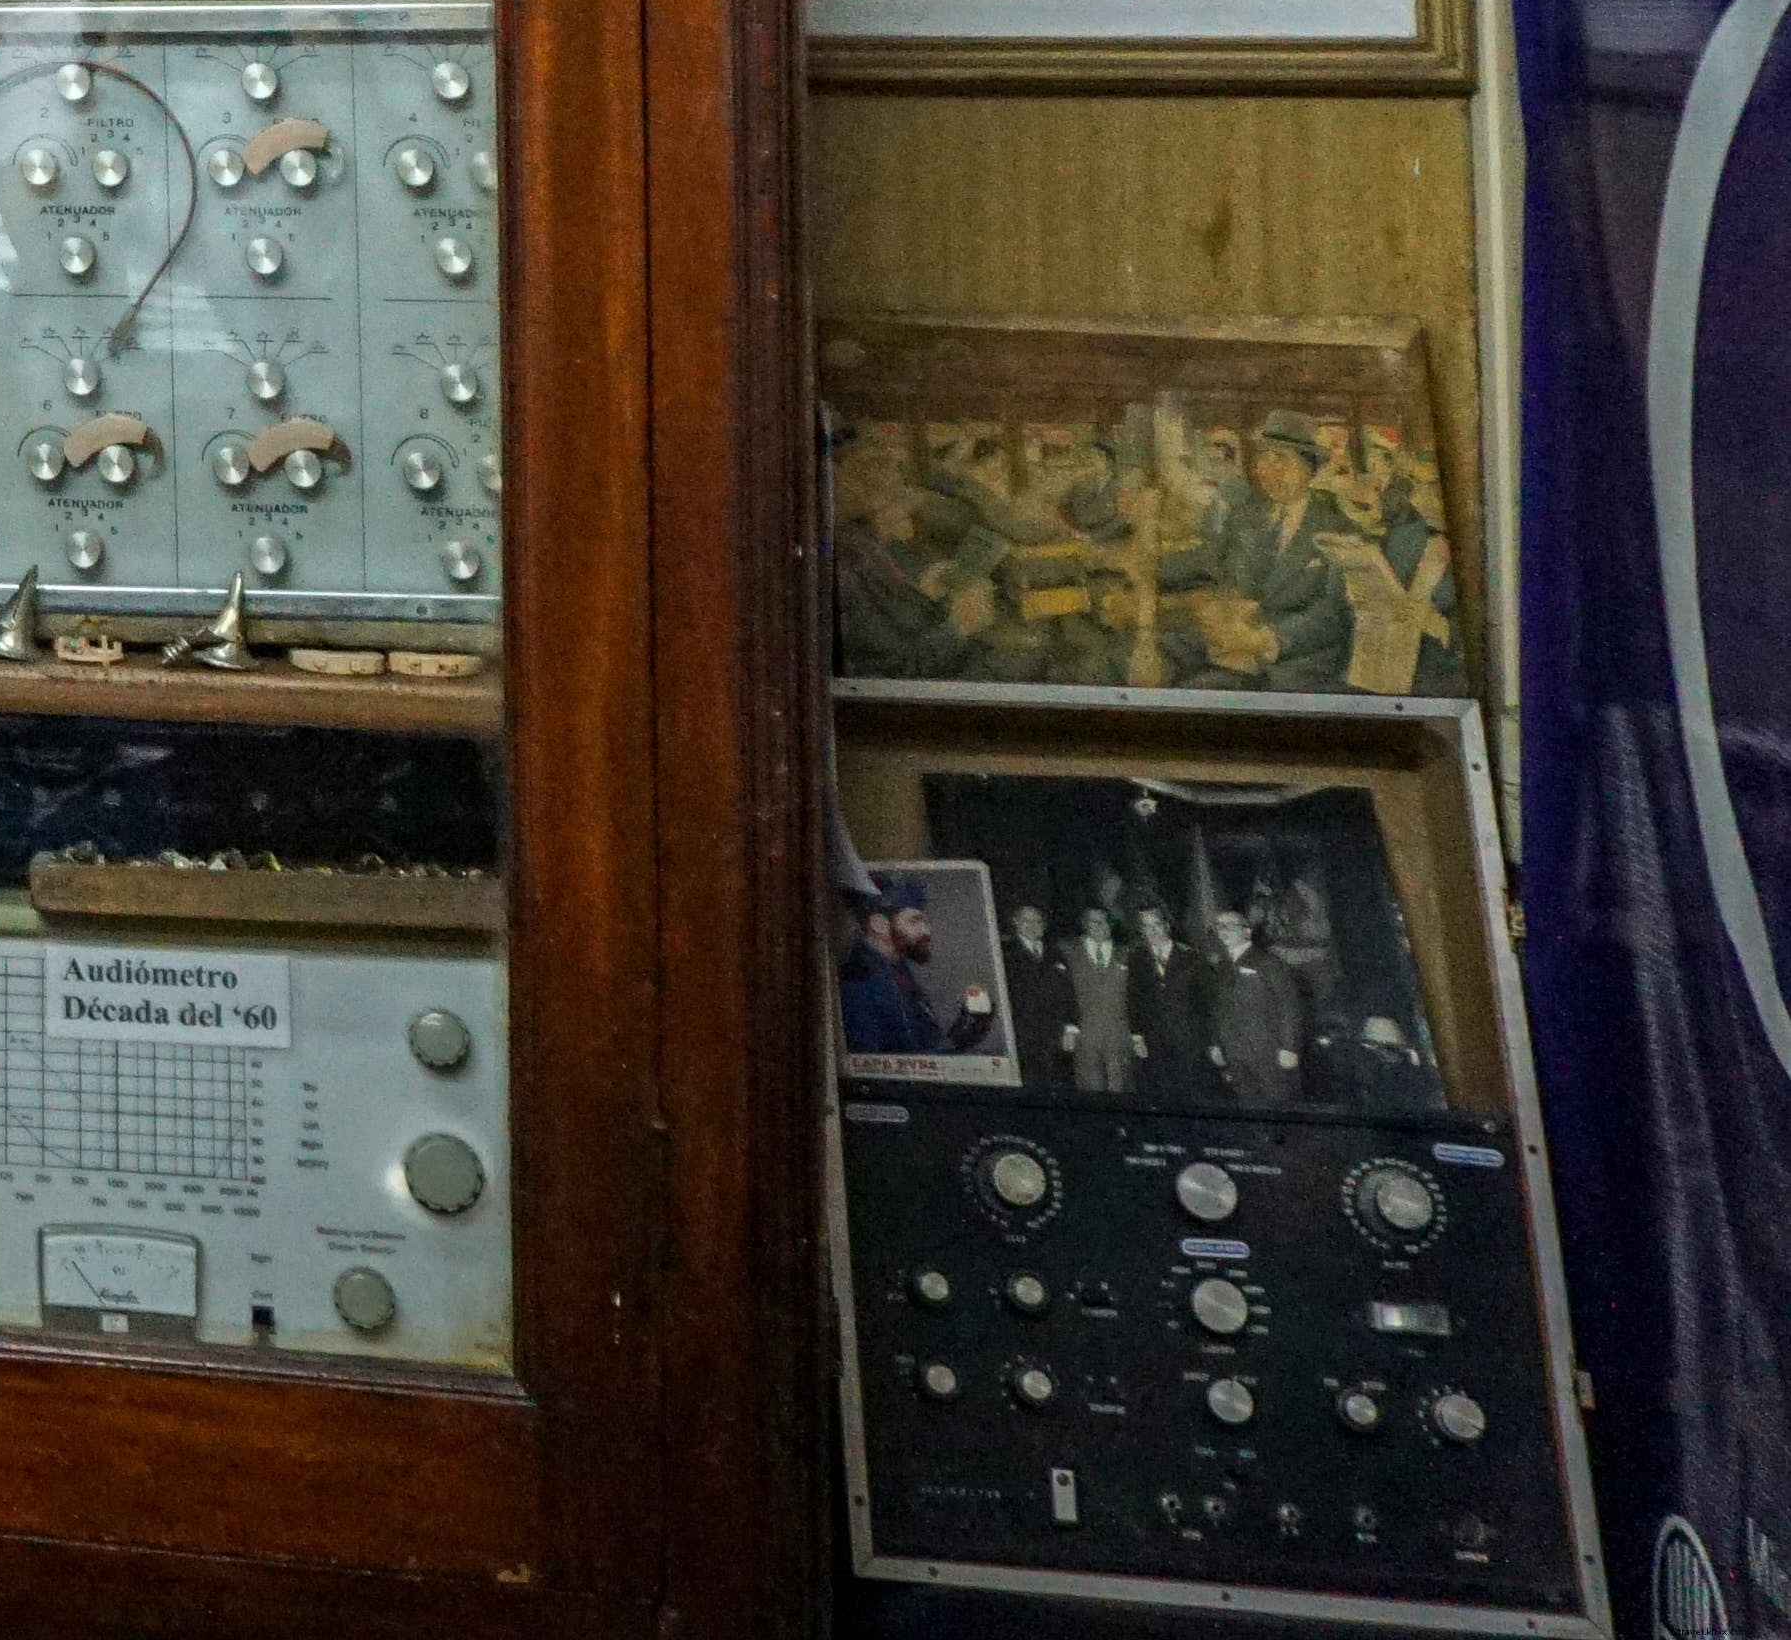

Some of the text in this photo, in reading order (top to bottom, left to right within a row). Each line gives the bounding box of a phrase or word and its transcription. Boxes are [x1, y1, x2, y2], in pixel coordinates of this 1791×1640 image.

[87, 117, 135, 129] FILTRO
[39, 205, 116, 217] ATENUADOR
[224, 207, 303, 218] ATENUADOR
[48, 498, 124, 510] ATENUADOR
[231, 503, 309, 514] ATENUADOR
[62, 957, 239, 990] Audiómetro
[62, 995, 170, 1025] Década
[179, 1002, 223, 1028] del
